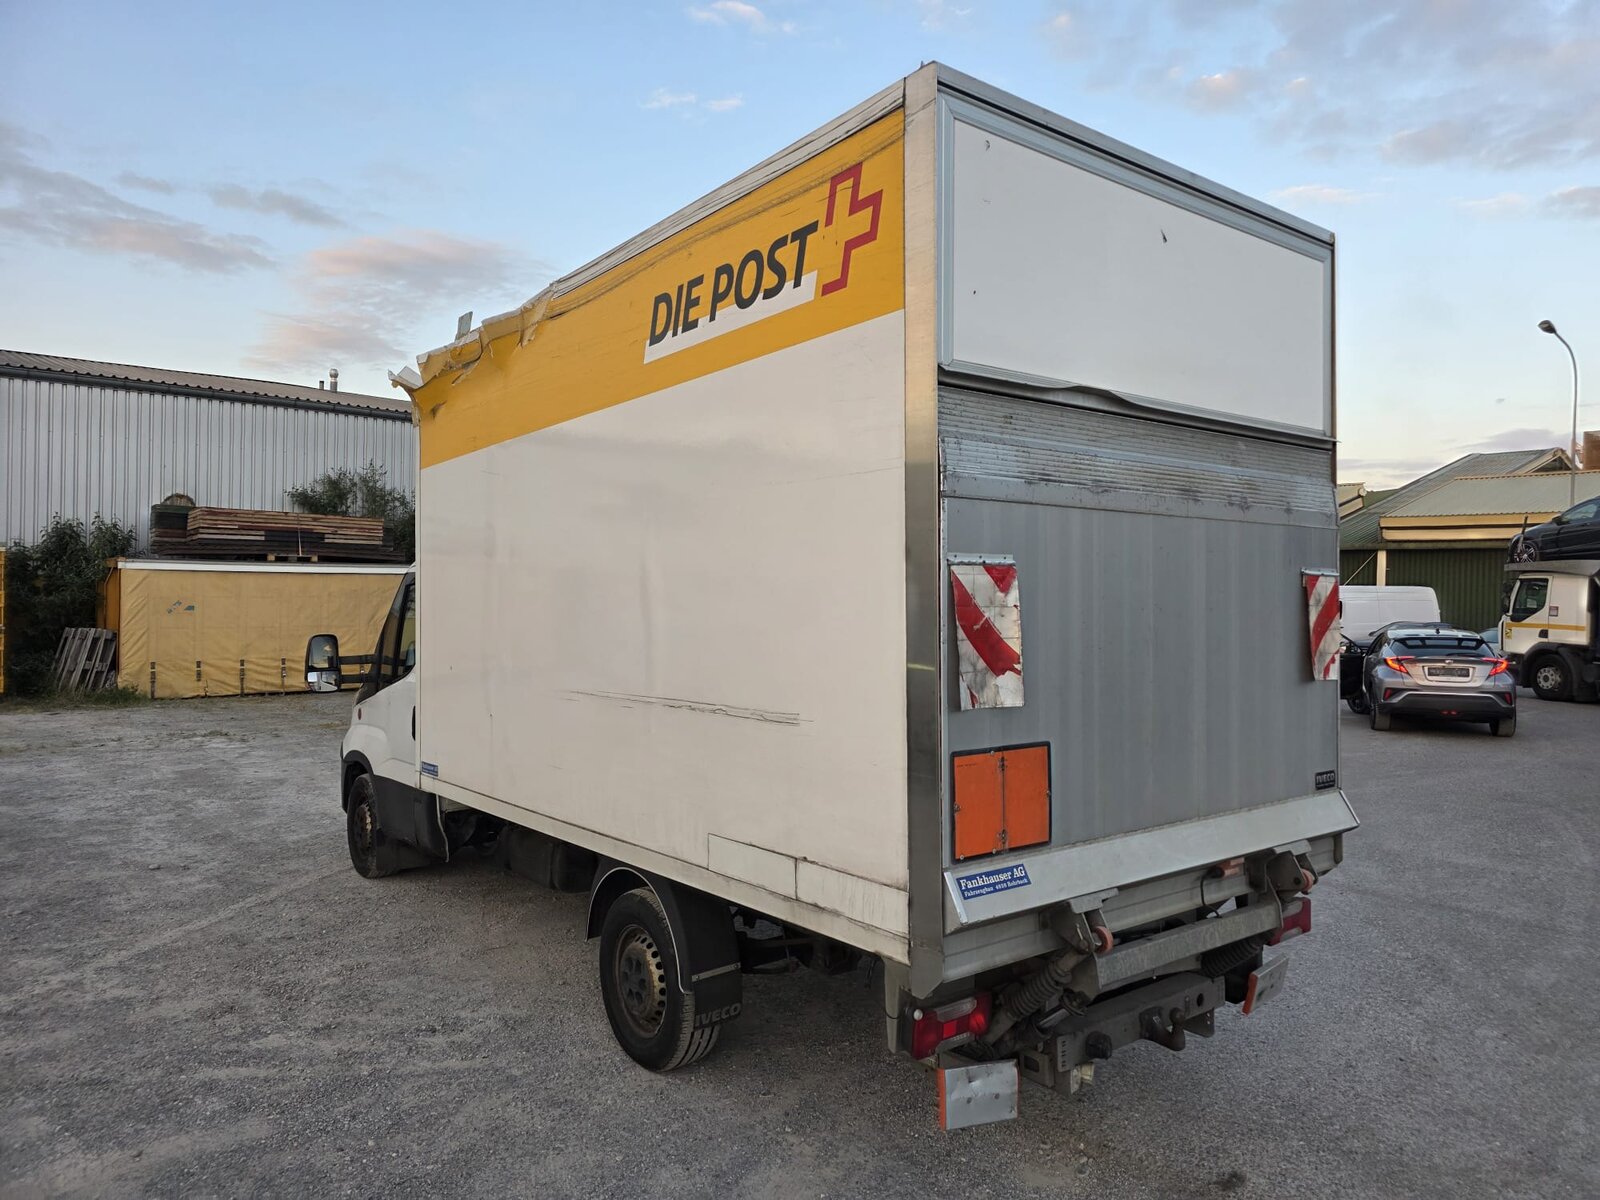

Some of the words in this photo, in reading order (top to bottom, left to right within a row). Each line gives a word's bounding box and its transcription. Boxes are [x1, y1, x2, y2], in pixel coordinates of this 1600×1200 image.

[649, 274, 704, 347] DIE
[709, 220, 819, 323] POST
[960, 872, 1011, 889] Fankhauser
[1013, 866, 1025, 878] AG
[695, 1002, 741, 1026] IVECO
